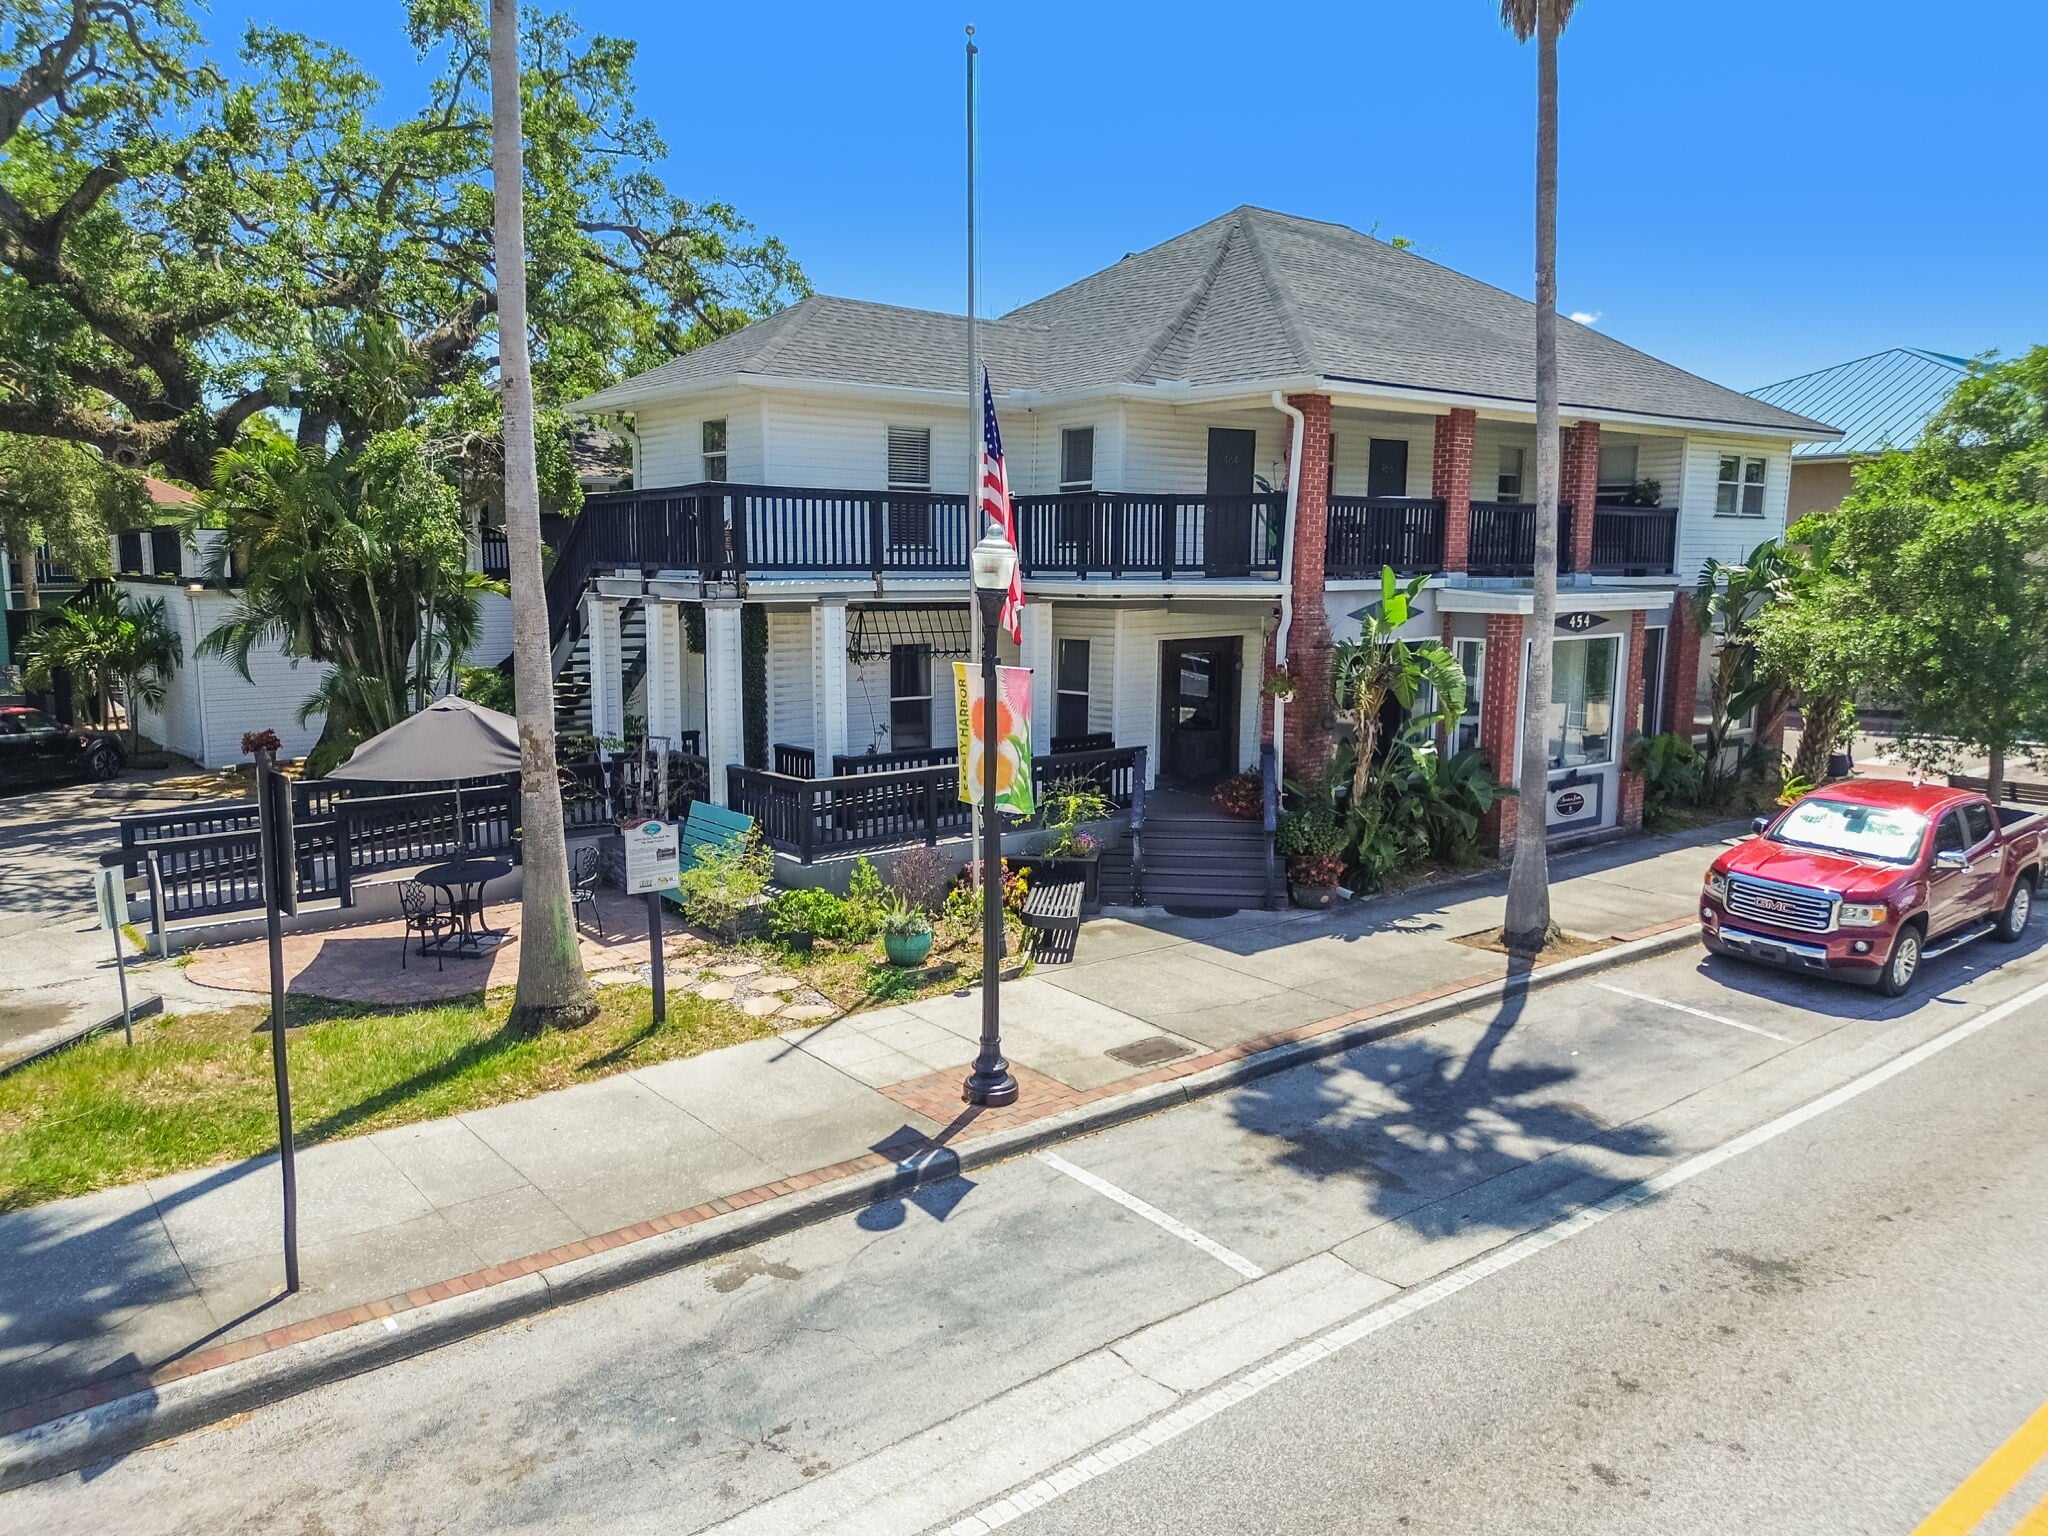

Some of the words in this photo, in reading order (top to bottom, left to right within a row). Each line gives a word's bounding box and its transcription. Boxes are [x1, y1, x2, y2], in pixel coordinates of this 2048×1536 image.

[1569, 614, 1591, 628] 454
[958, 679, 969, 737] HARBOR
[1754, 897, 1796, 914] GMC
